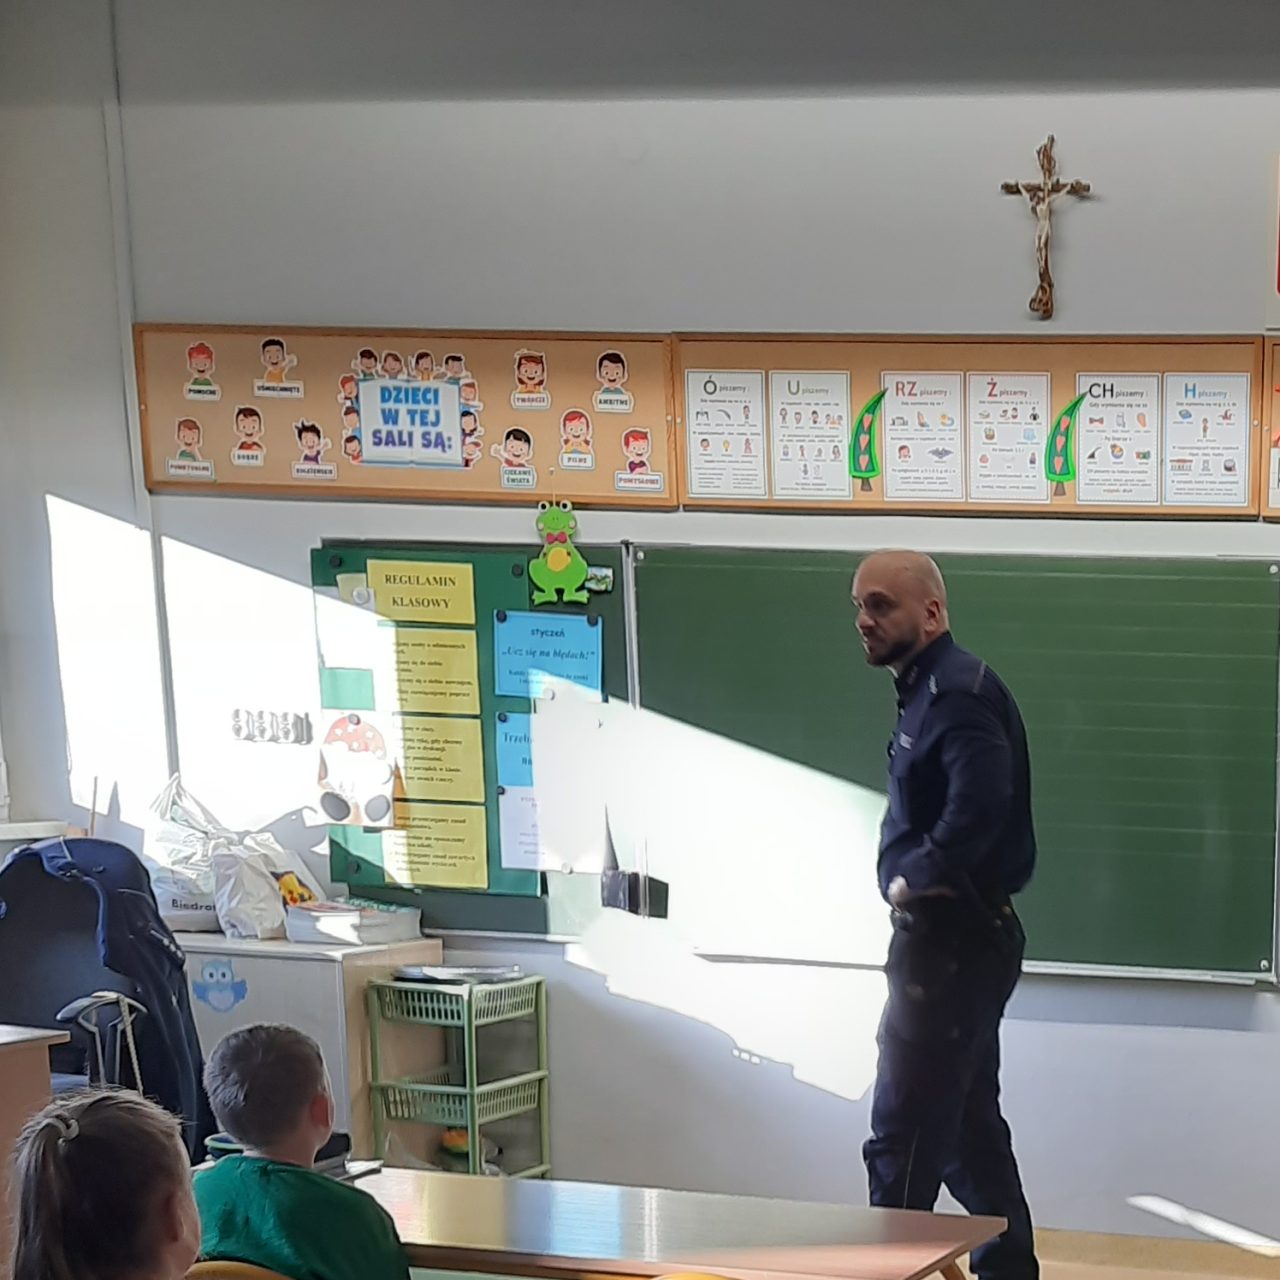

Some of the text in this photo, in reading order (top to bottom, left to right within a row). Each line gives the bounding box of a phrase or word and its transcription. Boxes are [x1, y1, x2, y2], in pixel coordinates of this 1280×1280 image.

[703, 374, 717, 395] Ó
[787, 379, 800, 395] U
[895, 381, 918, 397] RZ
[987, 377, 998, 397] Ż
[1088, 382, 1144, 399] CH piszemy
[1184, 382, 1196, 399] H
[380, 386, 440, 405] DZIECI
[381, 408, 441, 427] W TEJ
[372, 429, 452, 453] SALI SĄ:
[384, 574, 456, 587] REGULAMIN
[392, 596, 451, 609] KLASOWY
[530, 628, 565, 638] styczeń
